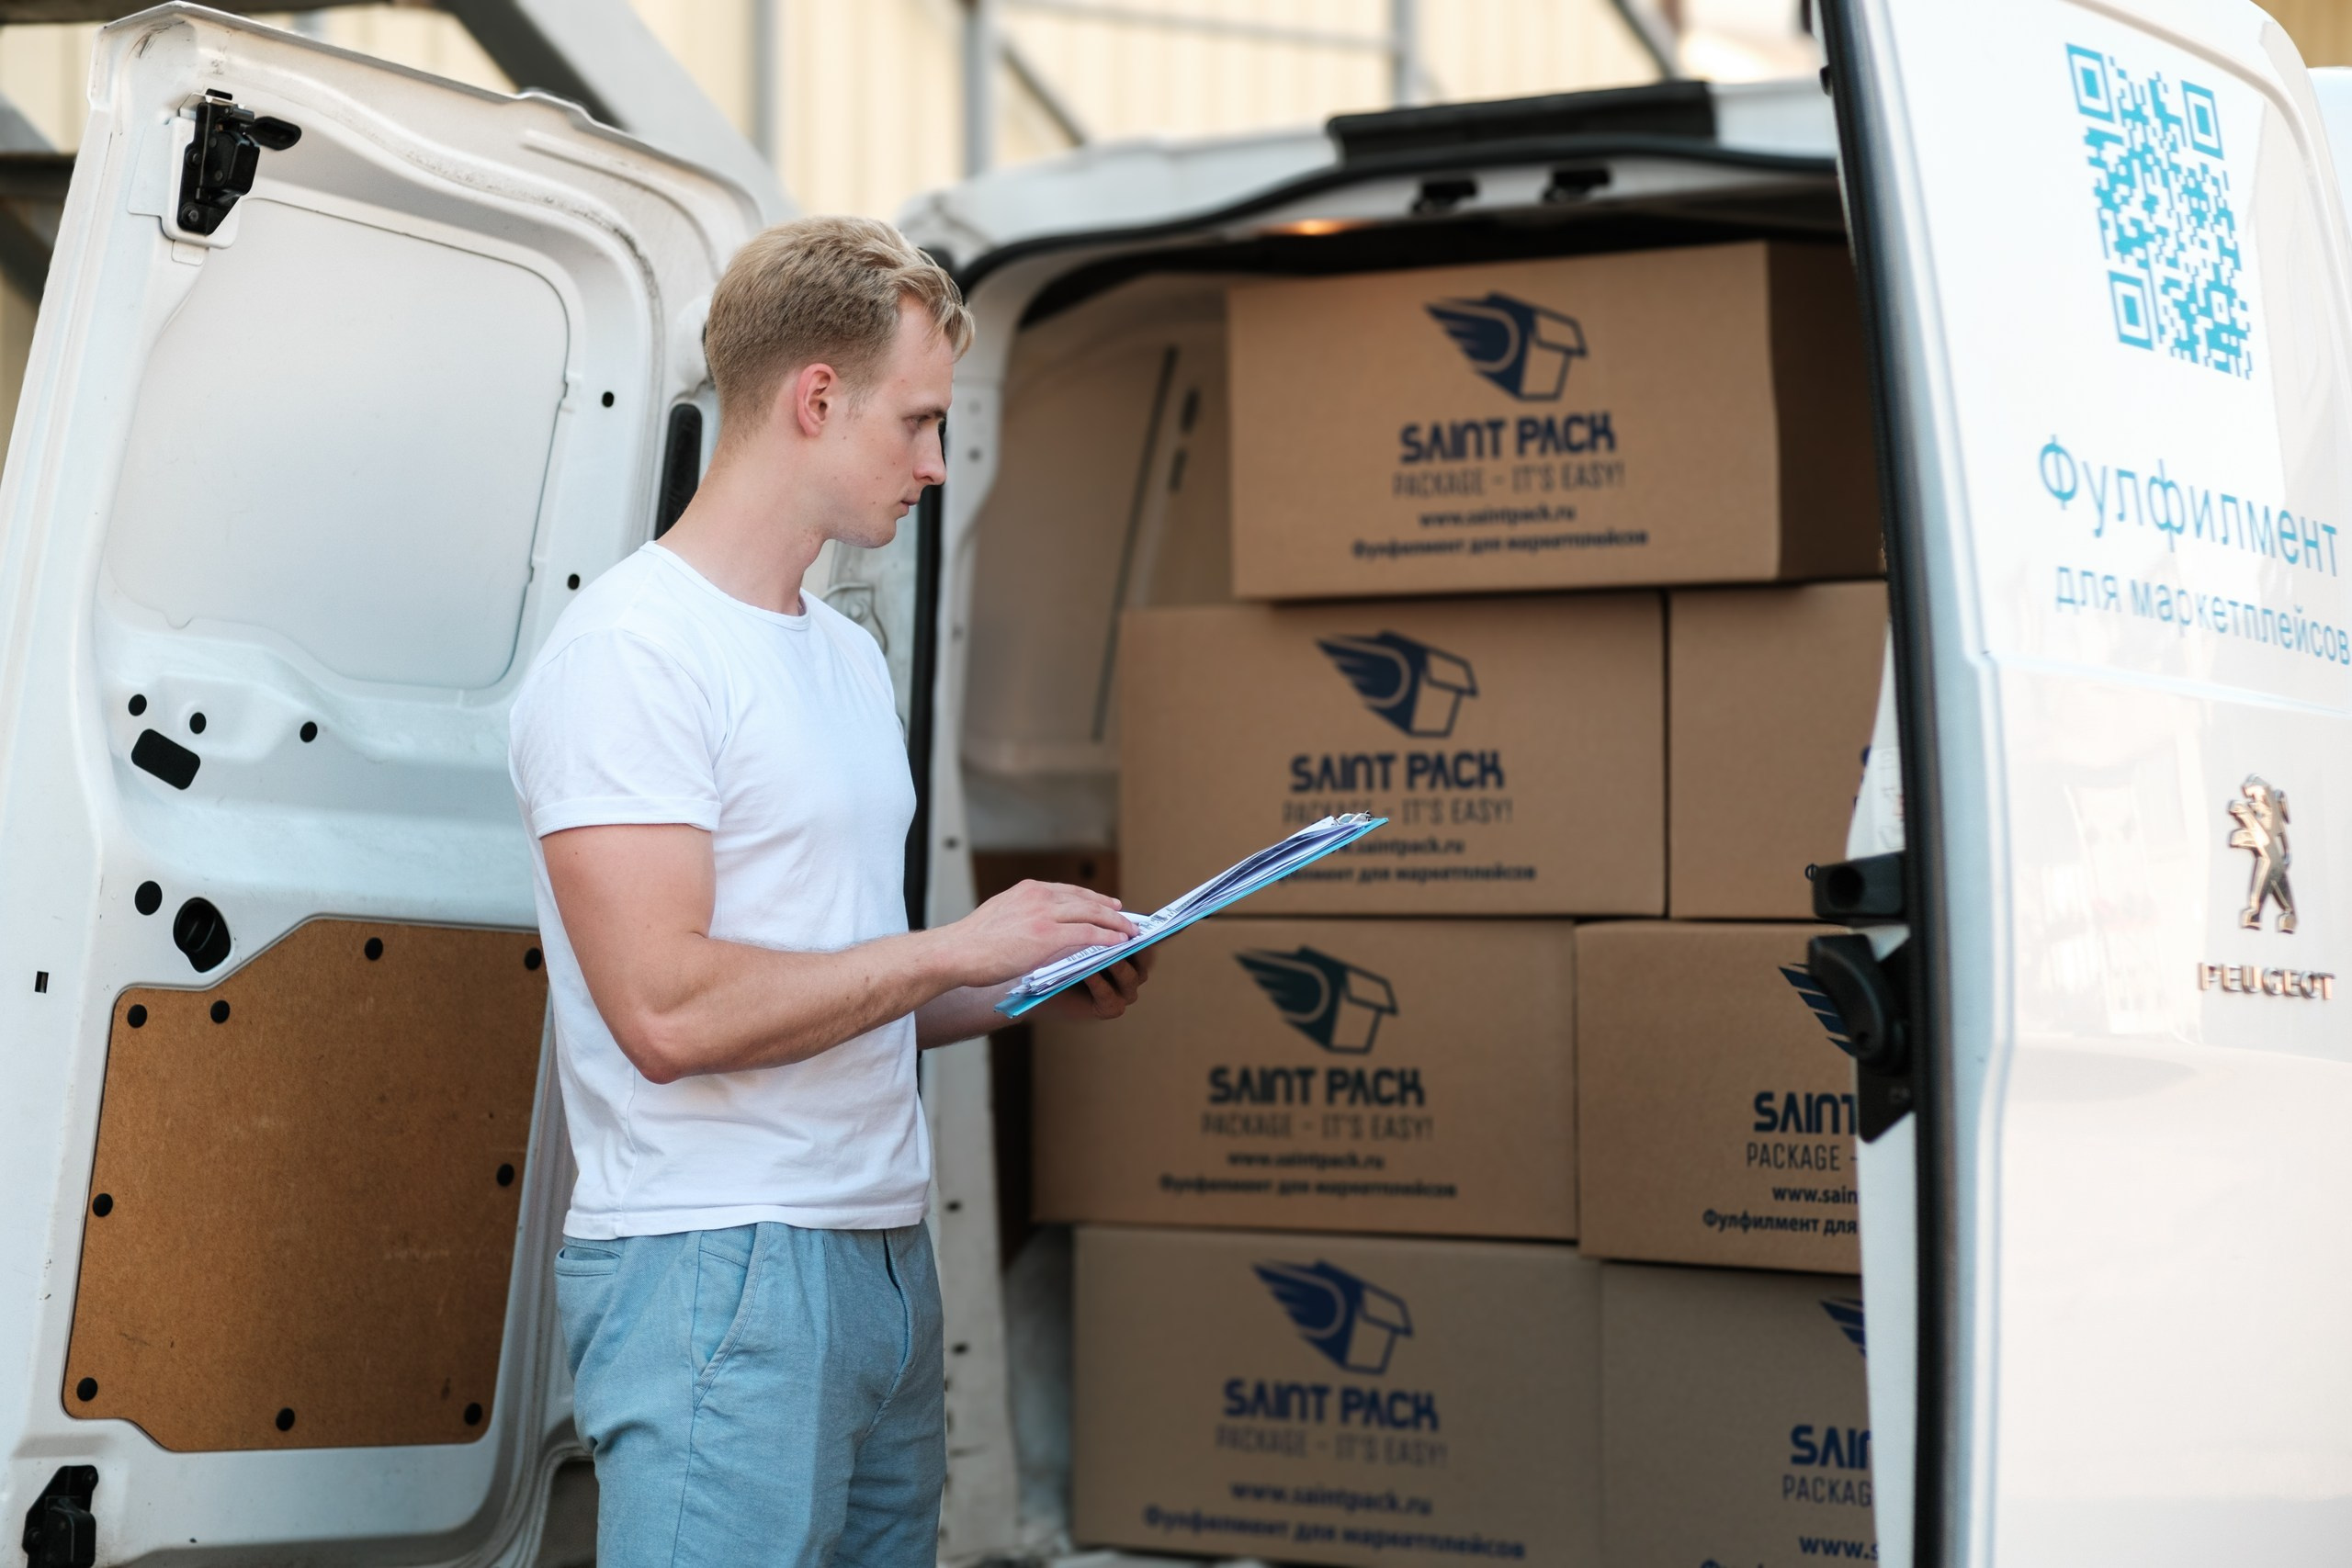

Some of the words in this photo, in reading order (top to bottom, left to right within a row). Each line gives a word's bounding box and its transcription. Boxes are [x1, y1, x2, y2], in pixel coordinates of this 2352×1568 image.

[1399, 417, 1507, 465] SAINT
[1515, 412, 1617, 457] PACK
[1392, 467, 1485, 499] PACKAGE
[1511, 464, 1555, 494] IT'S
[1560, 459, 1626, 491] EASY!
[2039, 434, 2337, 577] Фулфилмент
[2054, 566, 2121, 615] для
[2130, 579, 2350, 665] маркетплейсов
[1289, 751, 1396, 794] SAINT
[1405, 750, 1505, 791] PACK
[1402, 797, 1444, 827] IT'S
[1451, 796, 1514, 826] EASY!
[2198, 963, 2336, 1000] PEUGEOT
[1207, 1065, 1317, 1106] SAINT
[1325, 1066, 1426, 1108] PACK
[1201, 1112, 1293, 1139] PACKAGE
[1321, 1113, 1364, 1141] IT'S
[1371, 1114, 1434, 1142] EASY!
[1747, 1142, 1841, 1171] PACKAGE
[1702, 1208, 1821, 1235] Фулфилмент
[1823, 1218, 1858, 1236] для
[1223, 1378, 1332, 1424] SAINT
[1340, 1386, 1441, 1432] PACK
[1215, 1424, 1308, 1458] PACKAGE
[1335, 1434, 1378, 1463] IT'S
[1384, 1437, 1449, 1468] EASY!
